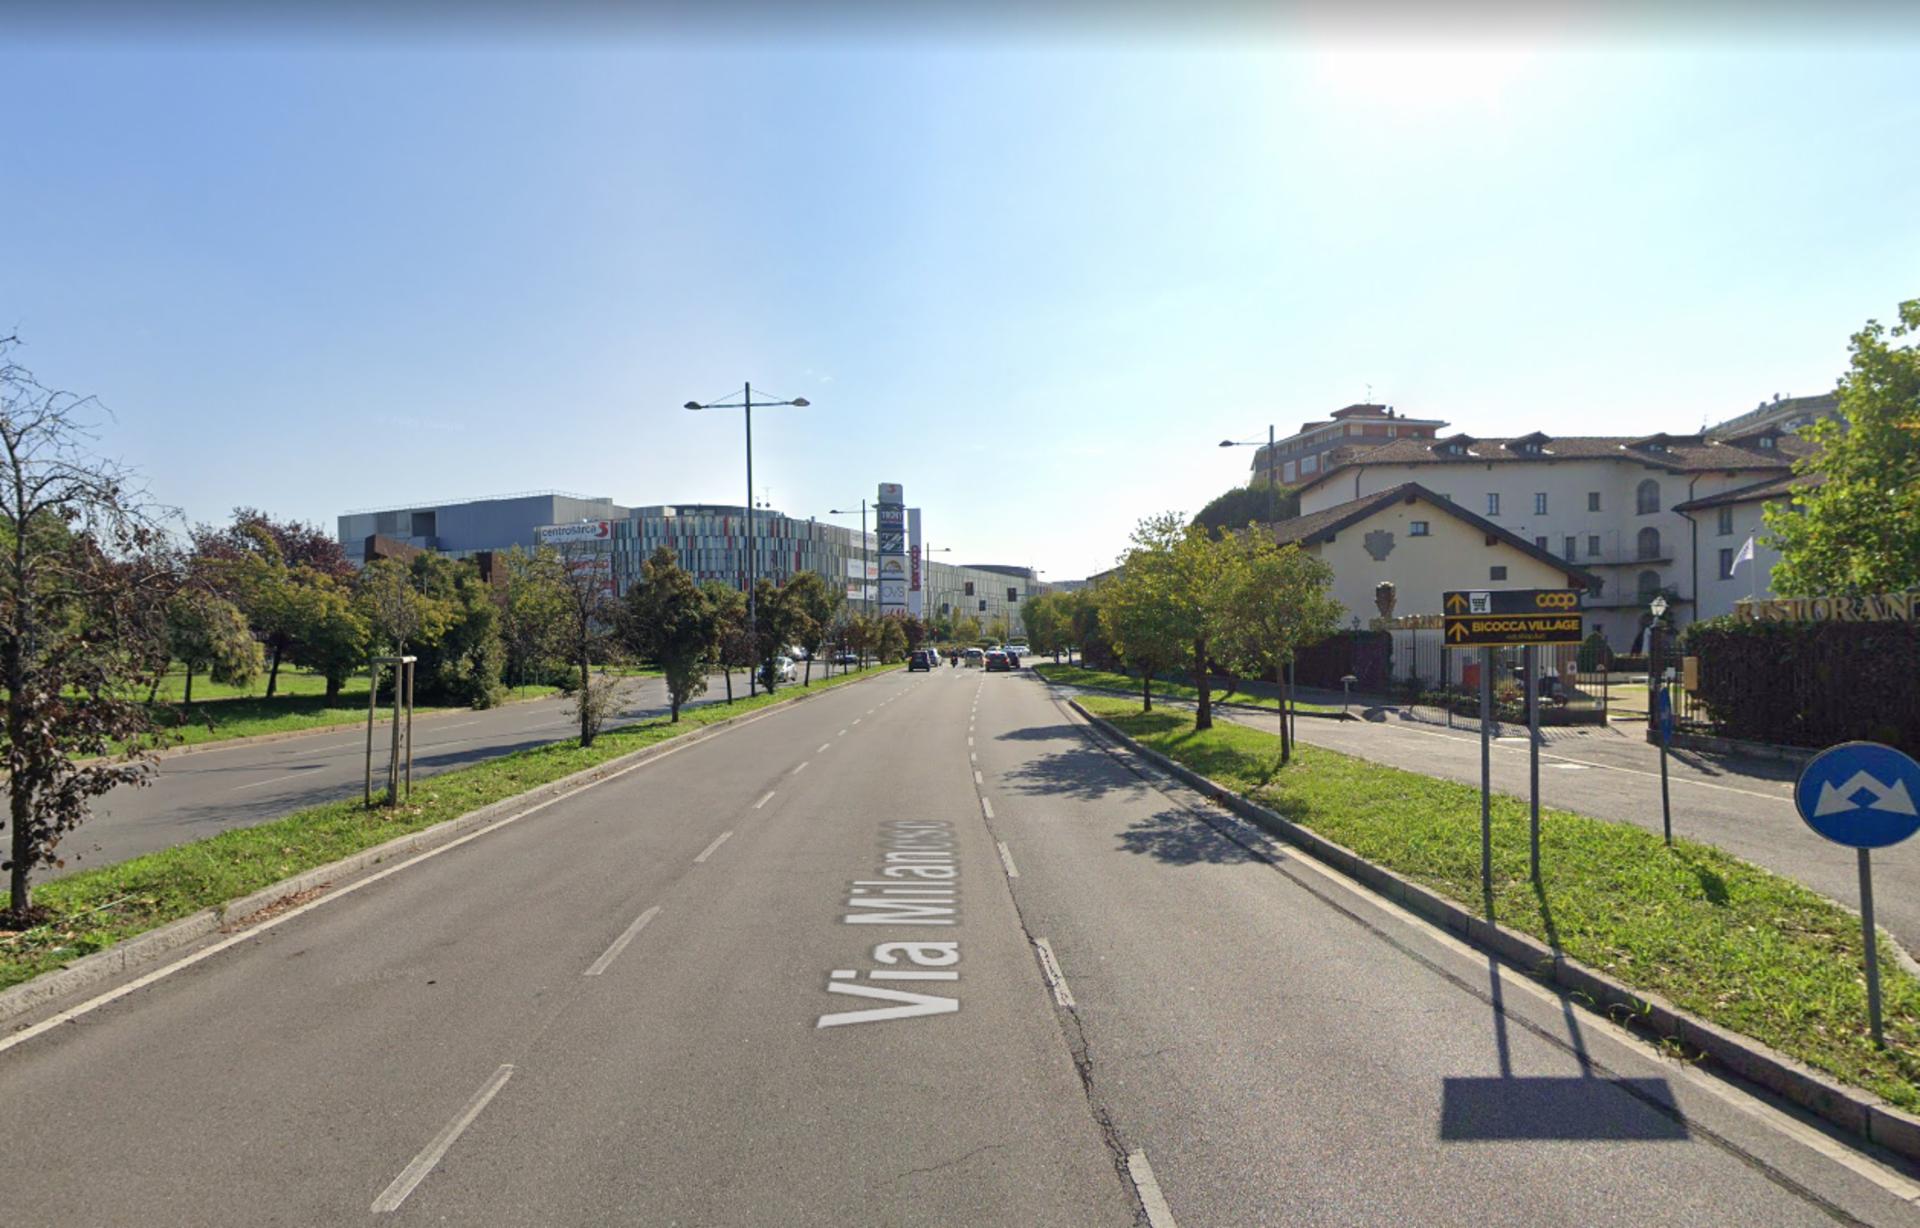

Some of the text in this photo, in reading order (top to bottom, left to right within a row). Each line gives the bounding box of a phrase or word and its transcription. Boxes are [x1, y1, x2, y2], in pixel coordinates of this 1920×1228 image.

[542, 525, 596, 537] centrosarca
[1471, 619, 1579, 632] BICOCCA VILLAGE
